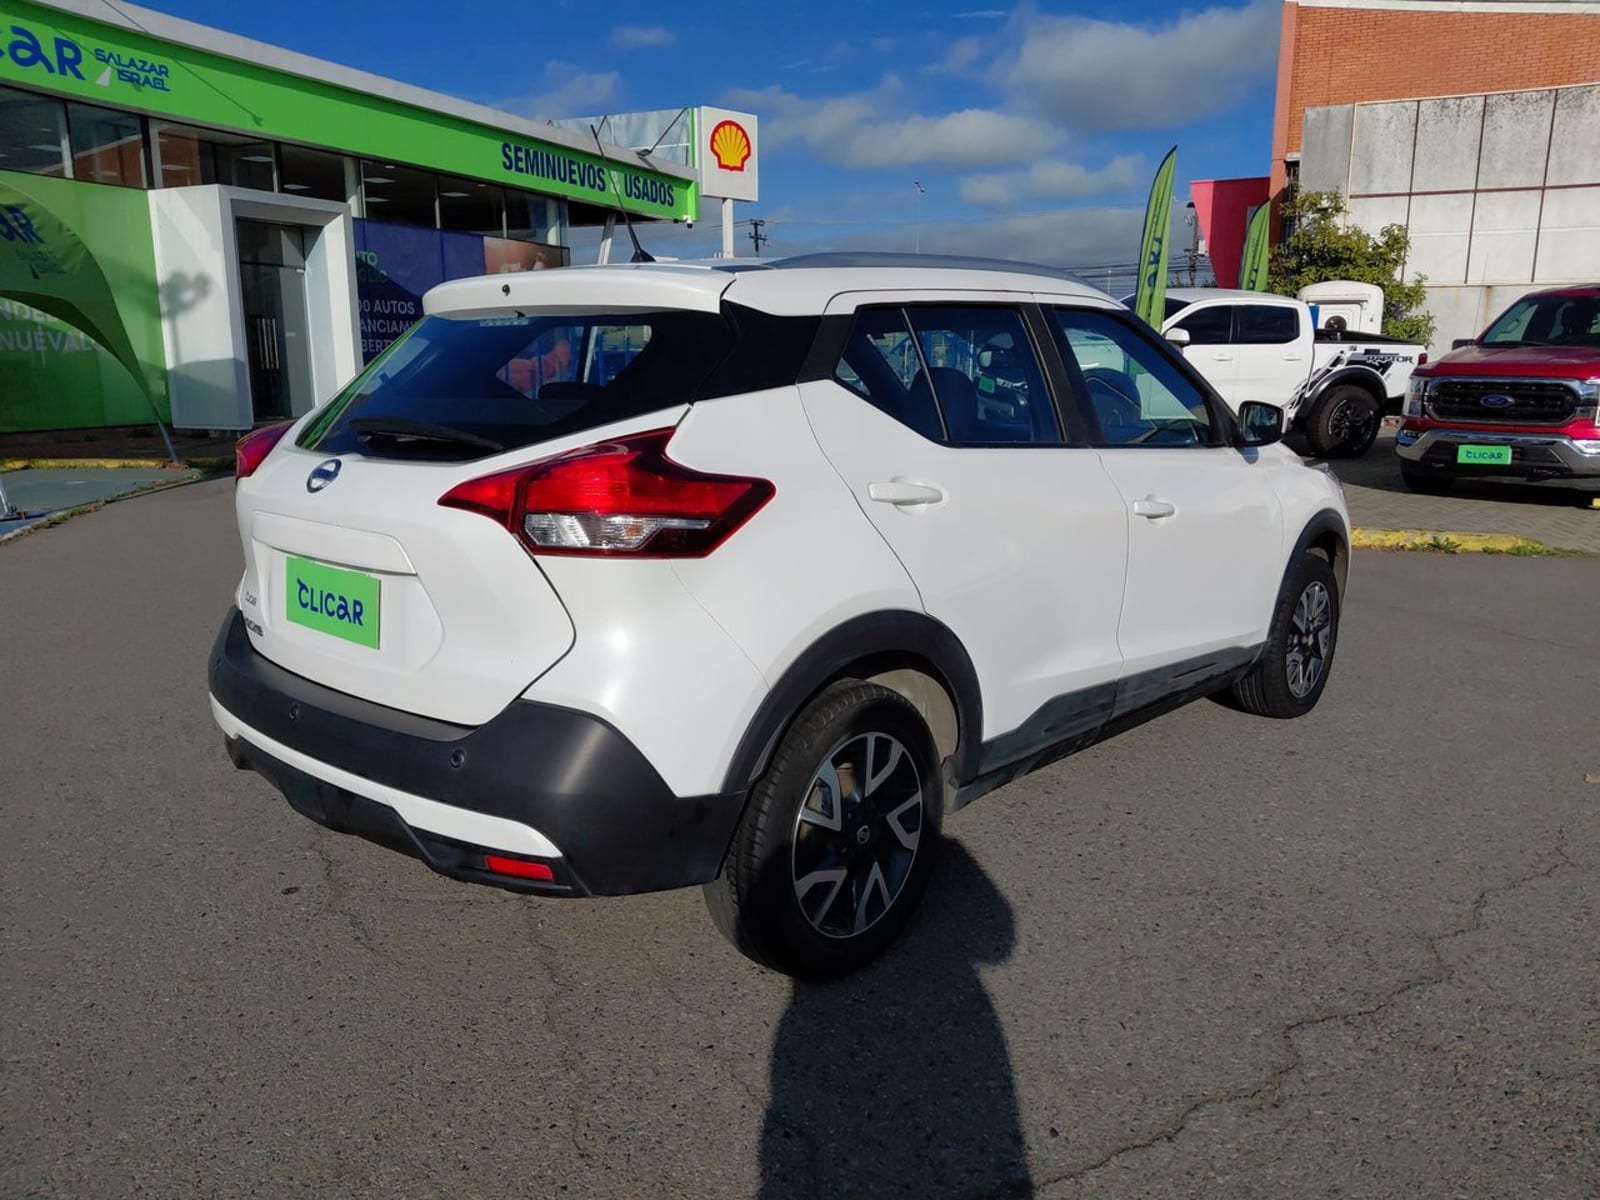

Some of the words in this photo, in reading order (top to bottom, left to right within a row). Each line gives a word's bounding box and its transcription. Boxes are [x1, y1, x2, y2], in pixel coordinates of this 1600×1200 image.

[94, 47, 169, 79] SALAZAR
[117, 68, 171, 93] ISRAEL
[502, 142, 606, 192] SEMINUEVOS
[624, 173, 675, 207] USADOS
[374, 300, 416, 315] AUTOS
